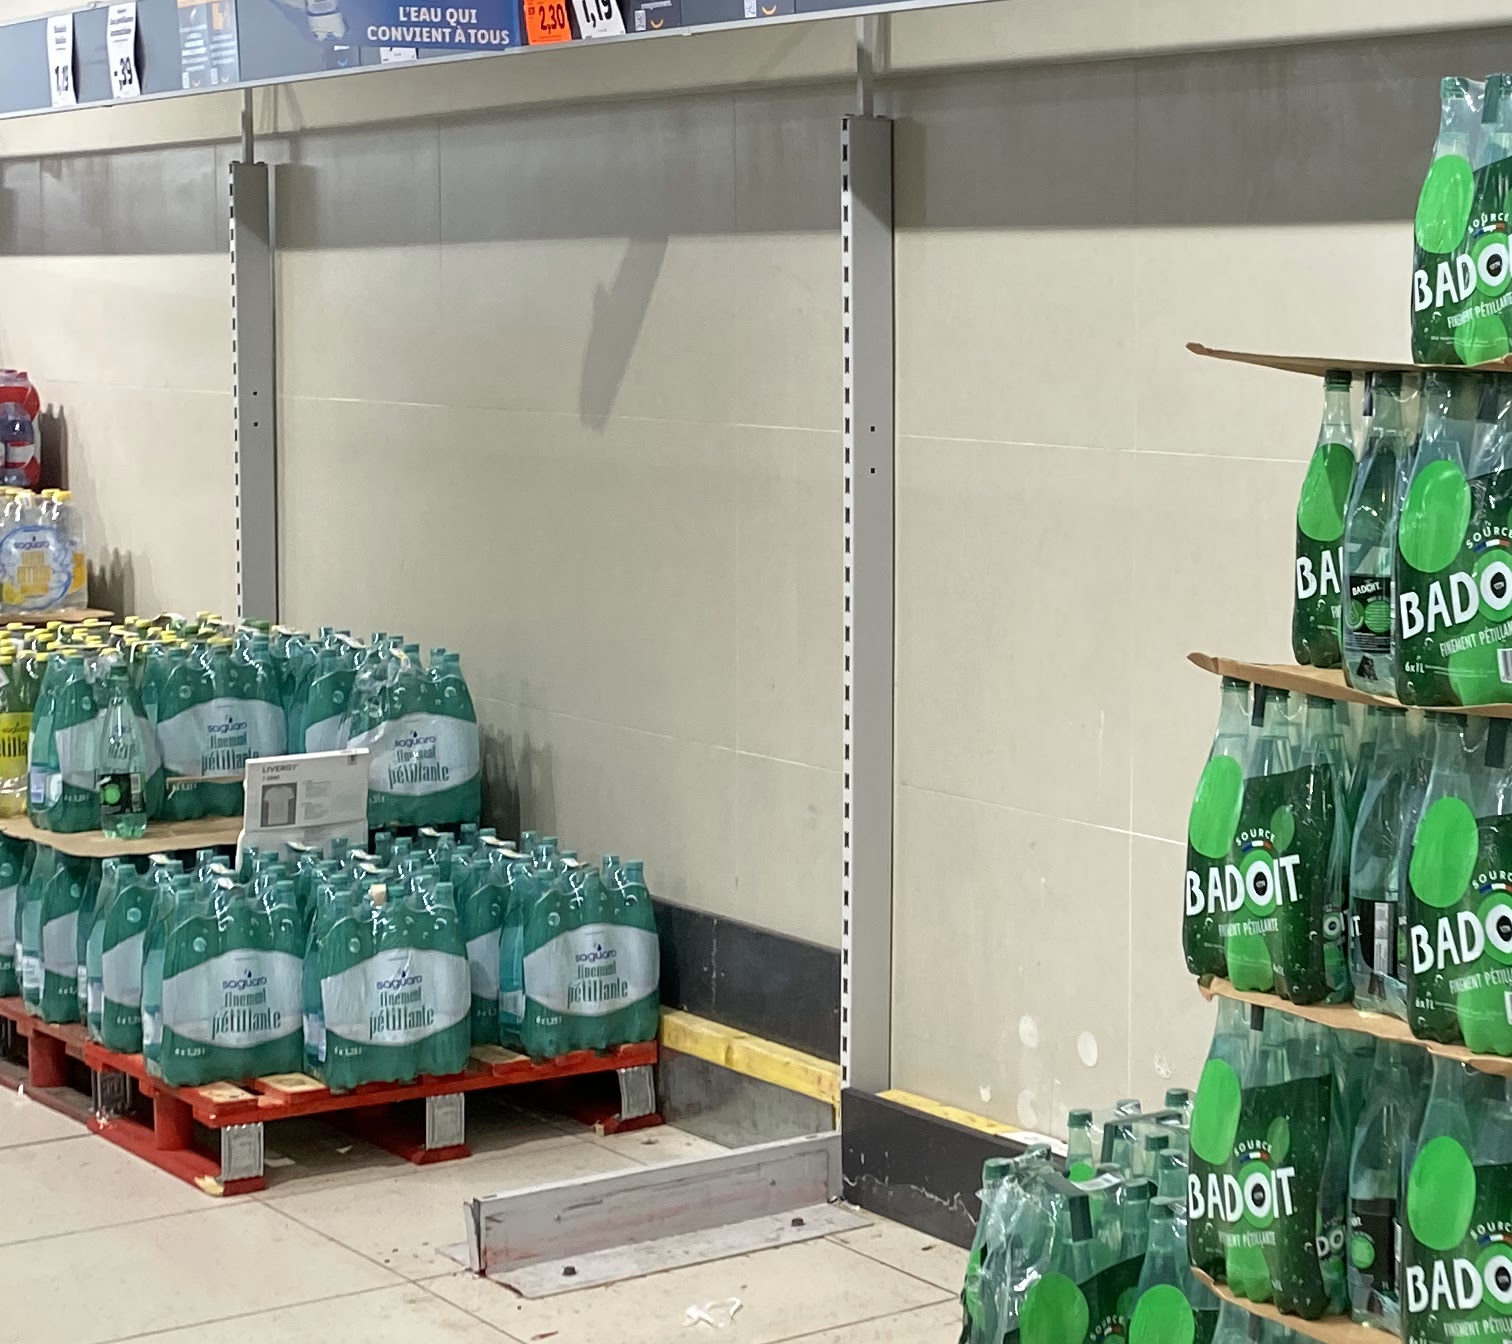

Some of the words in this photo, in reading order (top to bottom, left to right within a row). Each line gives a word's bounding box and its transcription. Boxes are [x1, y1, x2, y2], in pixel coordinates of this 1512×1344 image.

[399, 6, 441, 23] L'EAU
[445, 7, 478, 26] QUI
[538, 3, 565, 35] 2,30
[367, 26, 450, 42] CONVIENT
[455, 25, 466, 43] À
[471, 29, 510, 45] TOUS
[394, 736, 436, 748] saguaro
[388, 762, 449, 790] pétillante
[1235, 826, 1276, 847] SOURCE
[1185, 854, 1300, 916] BADOIT
[575, 949, 617, 963] saguaro
[222, 976, 267, 990] saguaro
[376, 975, 422, 990] saguaro
[567, 977, 628, 1010] pétillante
[211, 1008, 281, 1041] pétillante
[369, 1005, 434, 1040] pétillante
[1234, 1139, 1272, 1156] SOURCE
[1188, 1166, 1295, 1223] BADOIT
